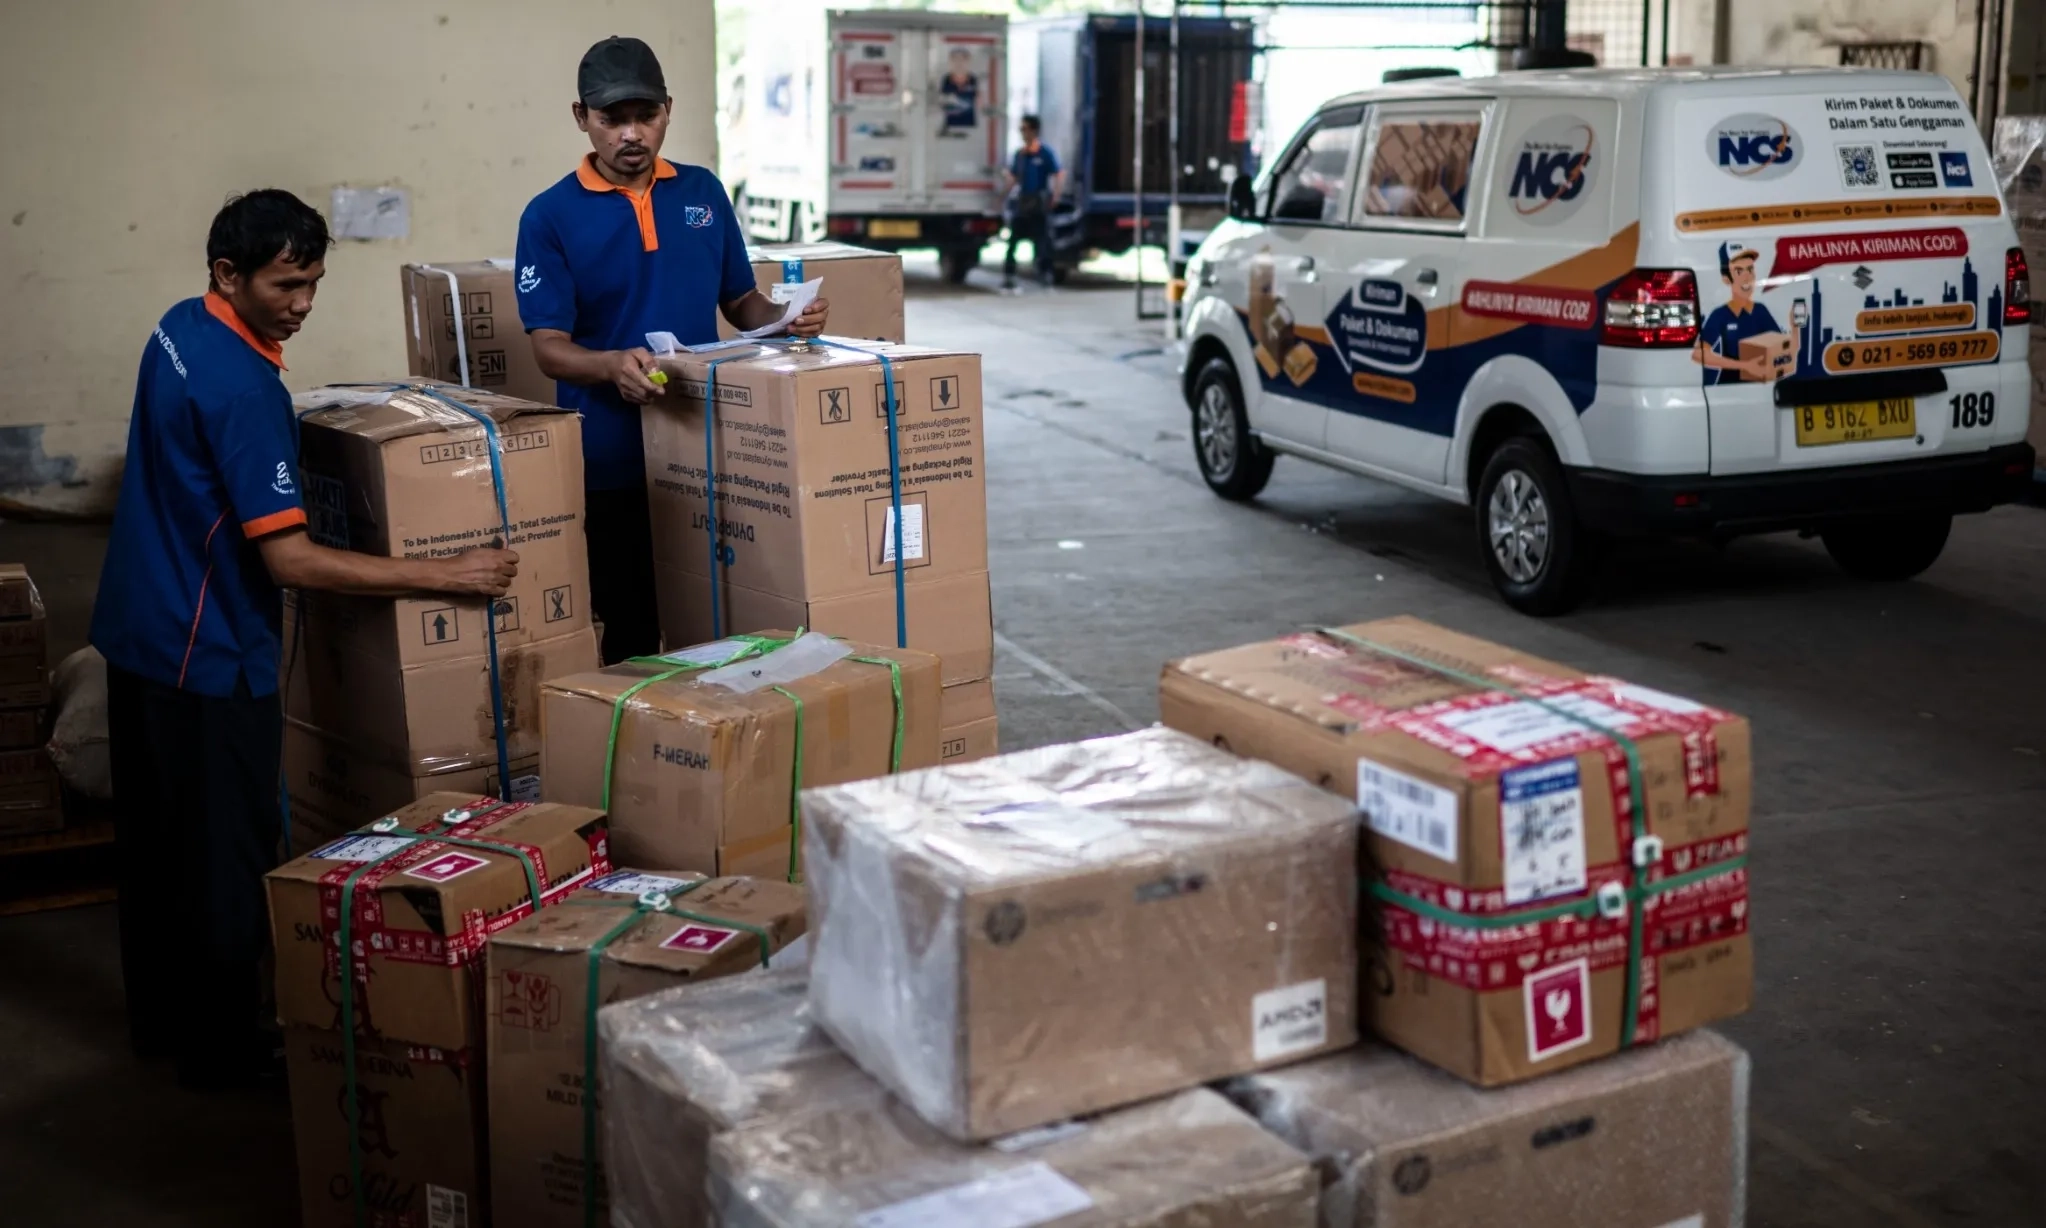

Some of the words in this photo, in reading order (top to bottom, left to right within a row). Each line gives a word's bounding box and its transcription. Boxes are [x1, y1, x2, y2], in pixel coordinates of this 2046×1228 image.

[1825, 98, 1857, 111] Kirim
[1860, 98, 1892, 110] Paket
[1896, 98, 1905, 110] &
[1907, 98, 1959, 110] Dokumen
[1829, 117, 1868, 130] Dalam
[1870, 116, 1896, 129] Satu
[1900, 115, 1965, 131] Genggaman
[1719, 135, 1793, 165] NCS
[1508, 152, 1591, 201] NCS
[1789, 238, 1861, 260] #AHLINYA
[1862, 236, 1921, 255] KIRIMAN
[1923, 235, 1957, 251] COD!
[521, 265, 535, 280] 24
[1515, 294, 1562, 318] KIRIMAN
[1562, 299, 1591, 321] COD!
[1864, 316, 1881, 325] Info
[1883, 314, 1904, 324] lebih
[1341, 313, 1365, 333] Paket
[1366, 317, 1373, 335] &
[1375, 317, 1419, 342] Dokumen
[1862, 347, 1891, 364] 021
[1907, 343, 1936, 360] 569
[1939, 341, 1957, 357] 69
[1962, 338, 1988, 356] 777
[478, 354, 506, 373] SNI
[1803, 407, 1814, 432] B
[1824, 403, 1868, 430] 9162
[1950, 391, 1994, 429] 189
[443, 448, 450, 457] 2
[459, 446, 466, 454] 3
[507, 439, 514, 447] 6
[522, 437, 529, 446] 7
[538, 435, 544, 443] 8
[898, 440, 972, 456] www.dynaplast.co.i
[899, 465, 911, 473] an
[912, 459, 950, 472] Packaging
[951, 457, 973, 467] Rigid
[667, 463, 695, 478] Provider
[831, 470, 866, 483] Provider
[953, 470, 962, 478] be
[963, 470, 973, 478] To
[654, 478, 685, 495] Solutions
[734, 472, 770, 493] Packaging
[908, 472, 951, 486] Indonesia's
[685, 484, 702, 499] Total
[772, 484, 790, 498] Rigid
[814, 487, 852, 499] Solutions
[853, 484, 874, 495] Total
[731, 494, 771, 514] Indonesia's
[772, 504, 781, 516] be
[782, 505, 792, 519] To
[403, 538, 415, 548] To
[417, 536, 428, 546] be
[430, 529, 482, 545] Indonesia's
[519, 518, 540, 530] Total
[541, 512, 576, 525] Solutions
[528, 529, 562, 541] Provider
[956, 743, 961, 752] 8
